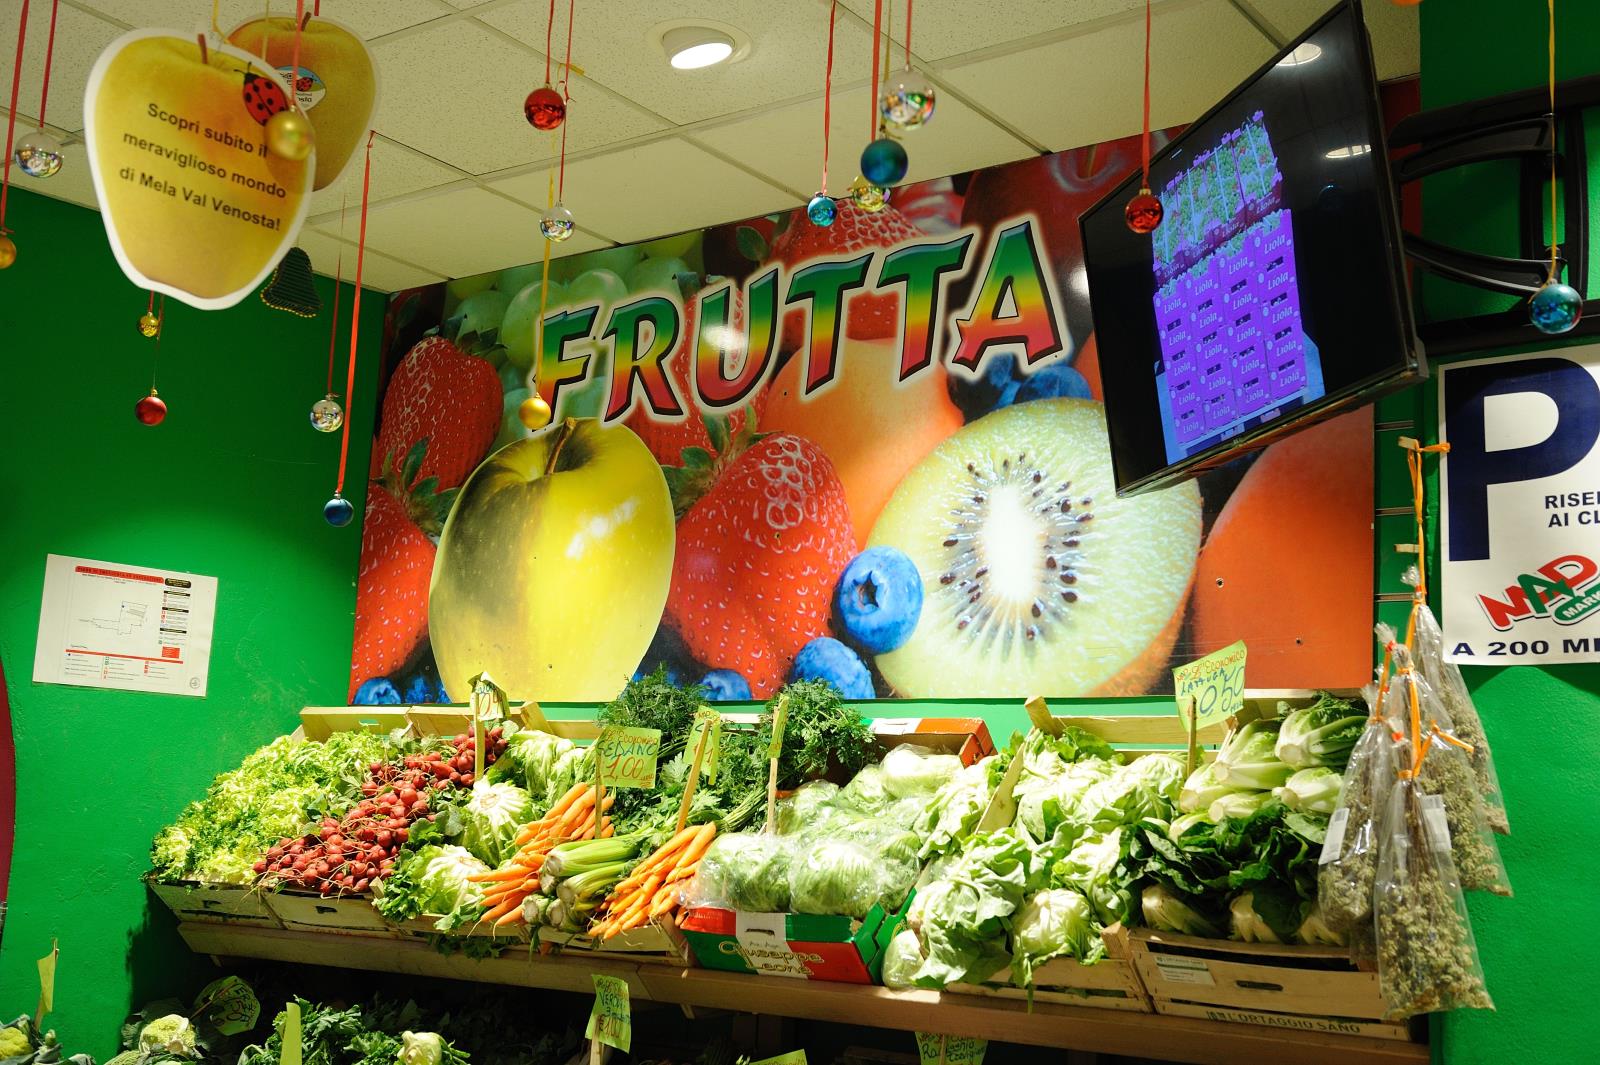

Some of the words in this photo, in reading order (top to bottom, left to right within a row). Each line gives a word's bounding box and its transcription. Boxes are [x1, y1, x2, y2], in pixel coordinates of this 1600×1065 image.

[147, 103, 200, 134] Scopri
[204, 127, 254, 153] subito
[258, 143, 268, 158] il
[123, 132, 227, 178] meraviglioso
[231, 172, 287, 199] mondo
[119, 167, 135, 182] di
[139, 172, 177, 197] Mela
[182, 187, 207, 207] Val
[212, 197, 281, 231] Venosta!
[530, 218, 1066, 425] FRUTTA
[1445, 357, 1600, 561] P
[1545, 491, 1600, 509] RISE
[1548, 512, 1569, 528] AI
[1477, 554, 1599, 628] MAD
[1452, 642, 1475, 656] A
[1487, 640, 1550, 656] 200
[1226, 1011, 1313, 1029] L'ORTAGGIO
[1317, 1021, 1361, 1034] SANO
